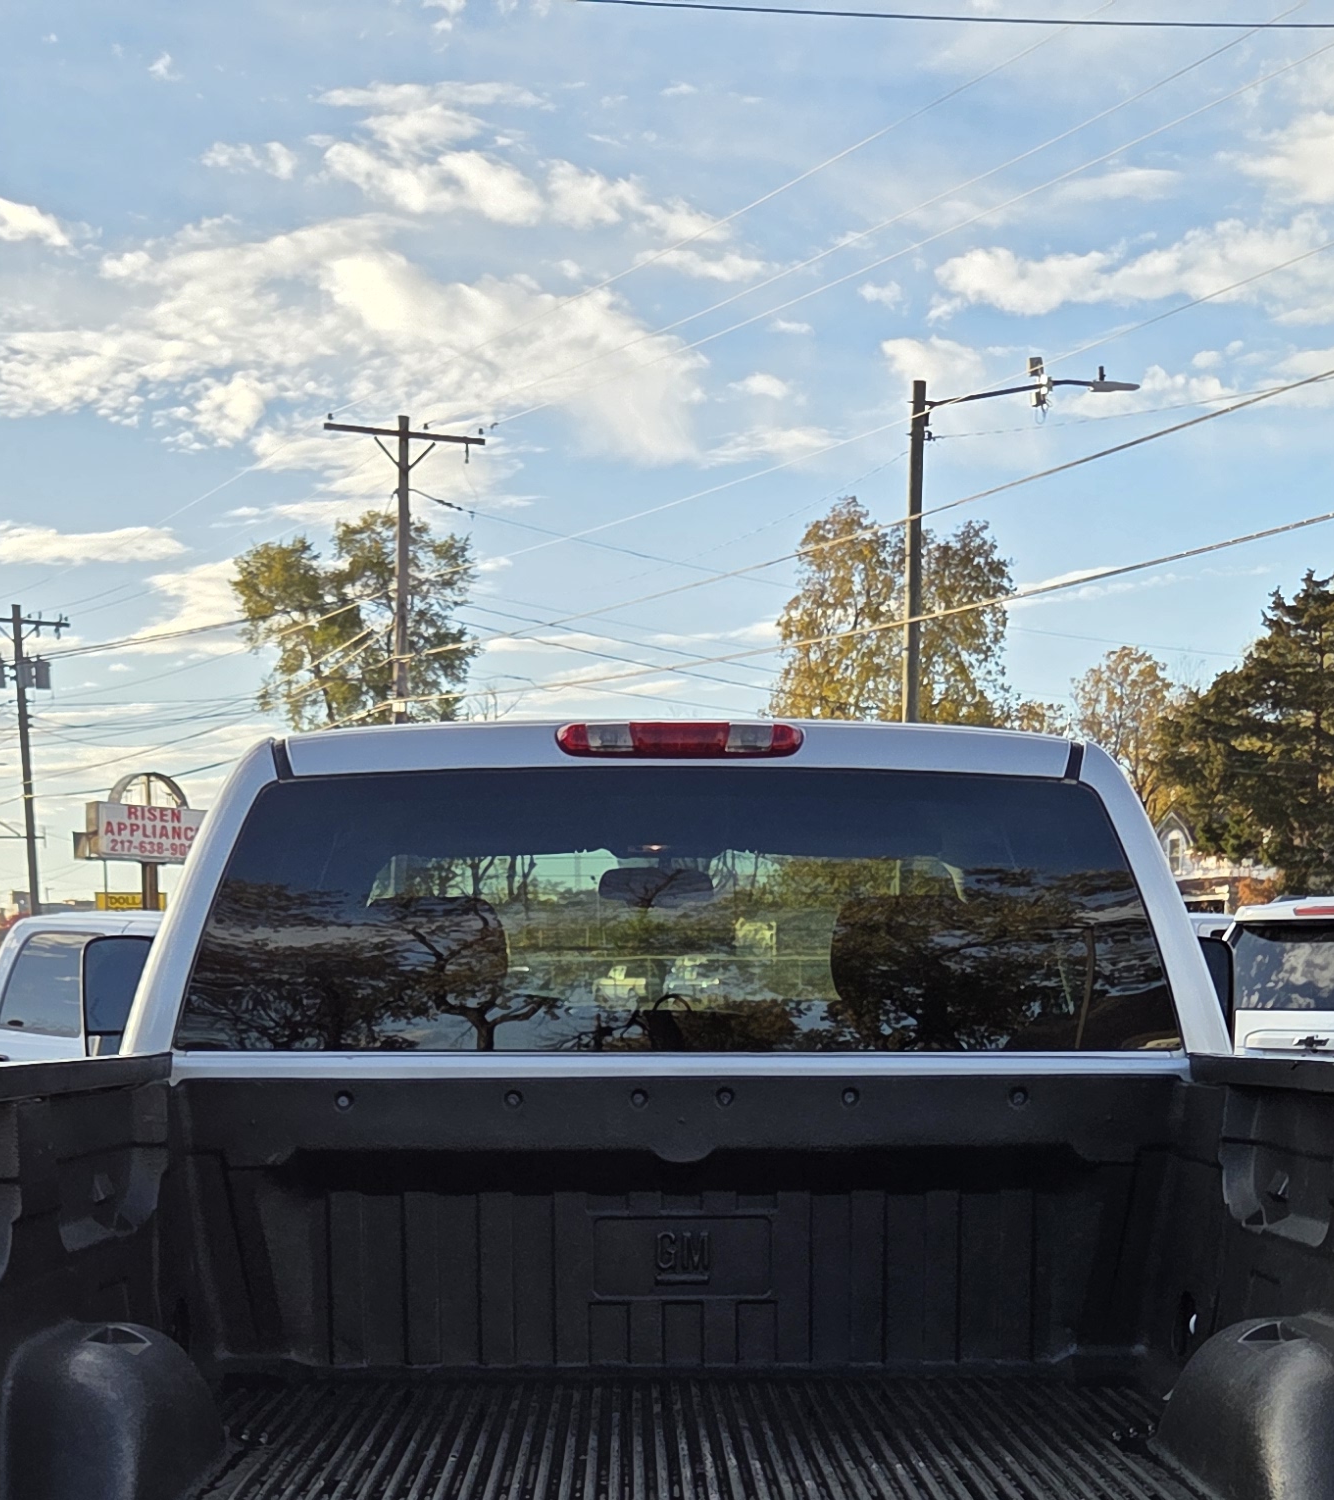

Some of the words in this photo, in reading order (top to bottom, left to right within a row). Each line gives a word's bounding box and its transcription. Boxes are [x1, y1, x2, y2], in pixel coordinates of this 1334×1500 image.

[127, 805, 181, 824] RISEN
[110, 838, 192, 857] 217-638-90
[655, 1230, 710, 1270] GM
